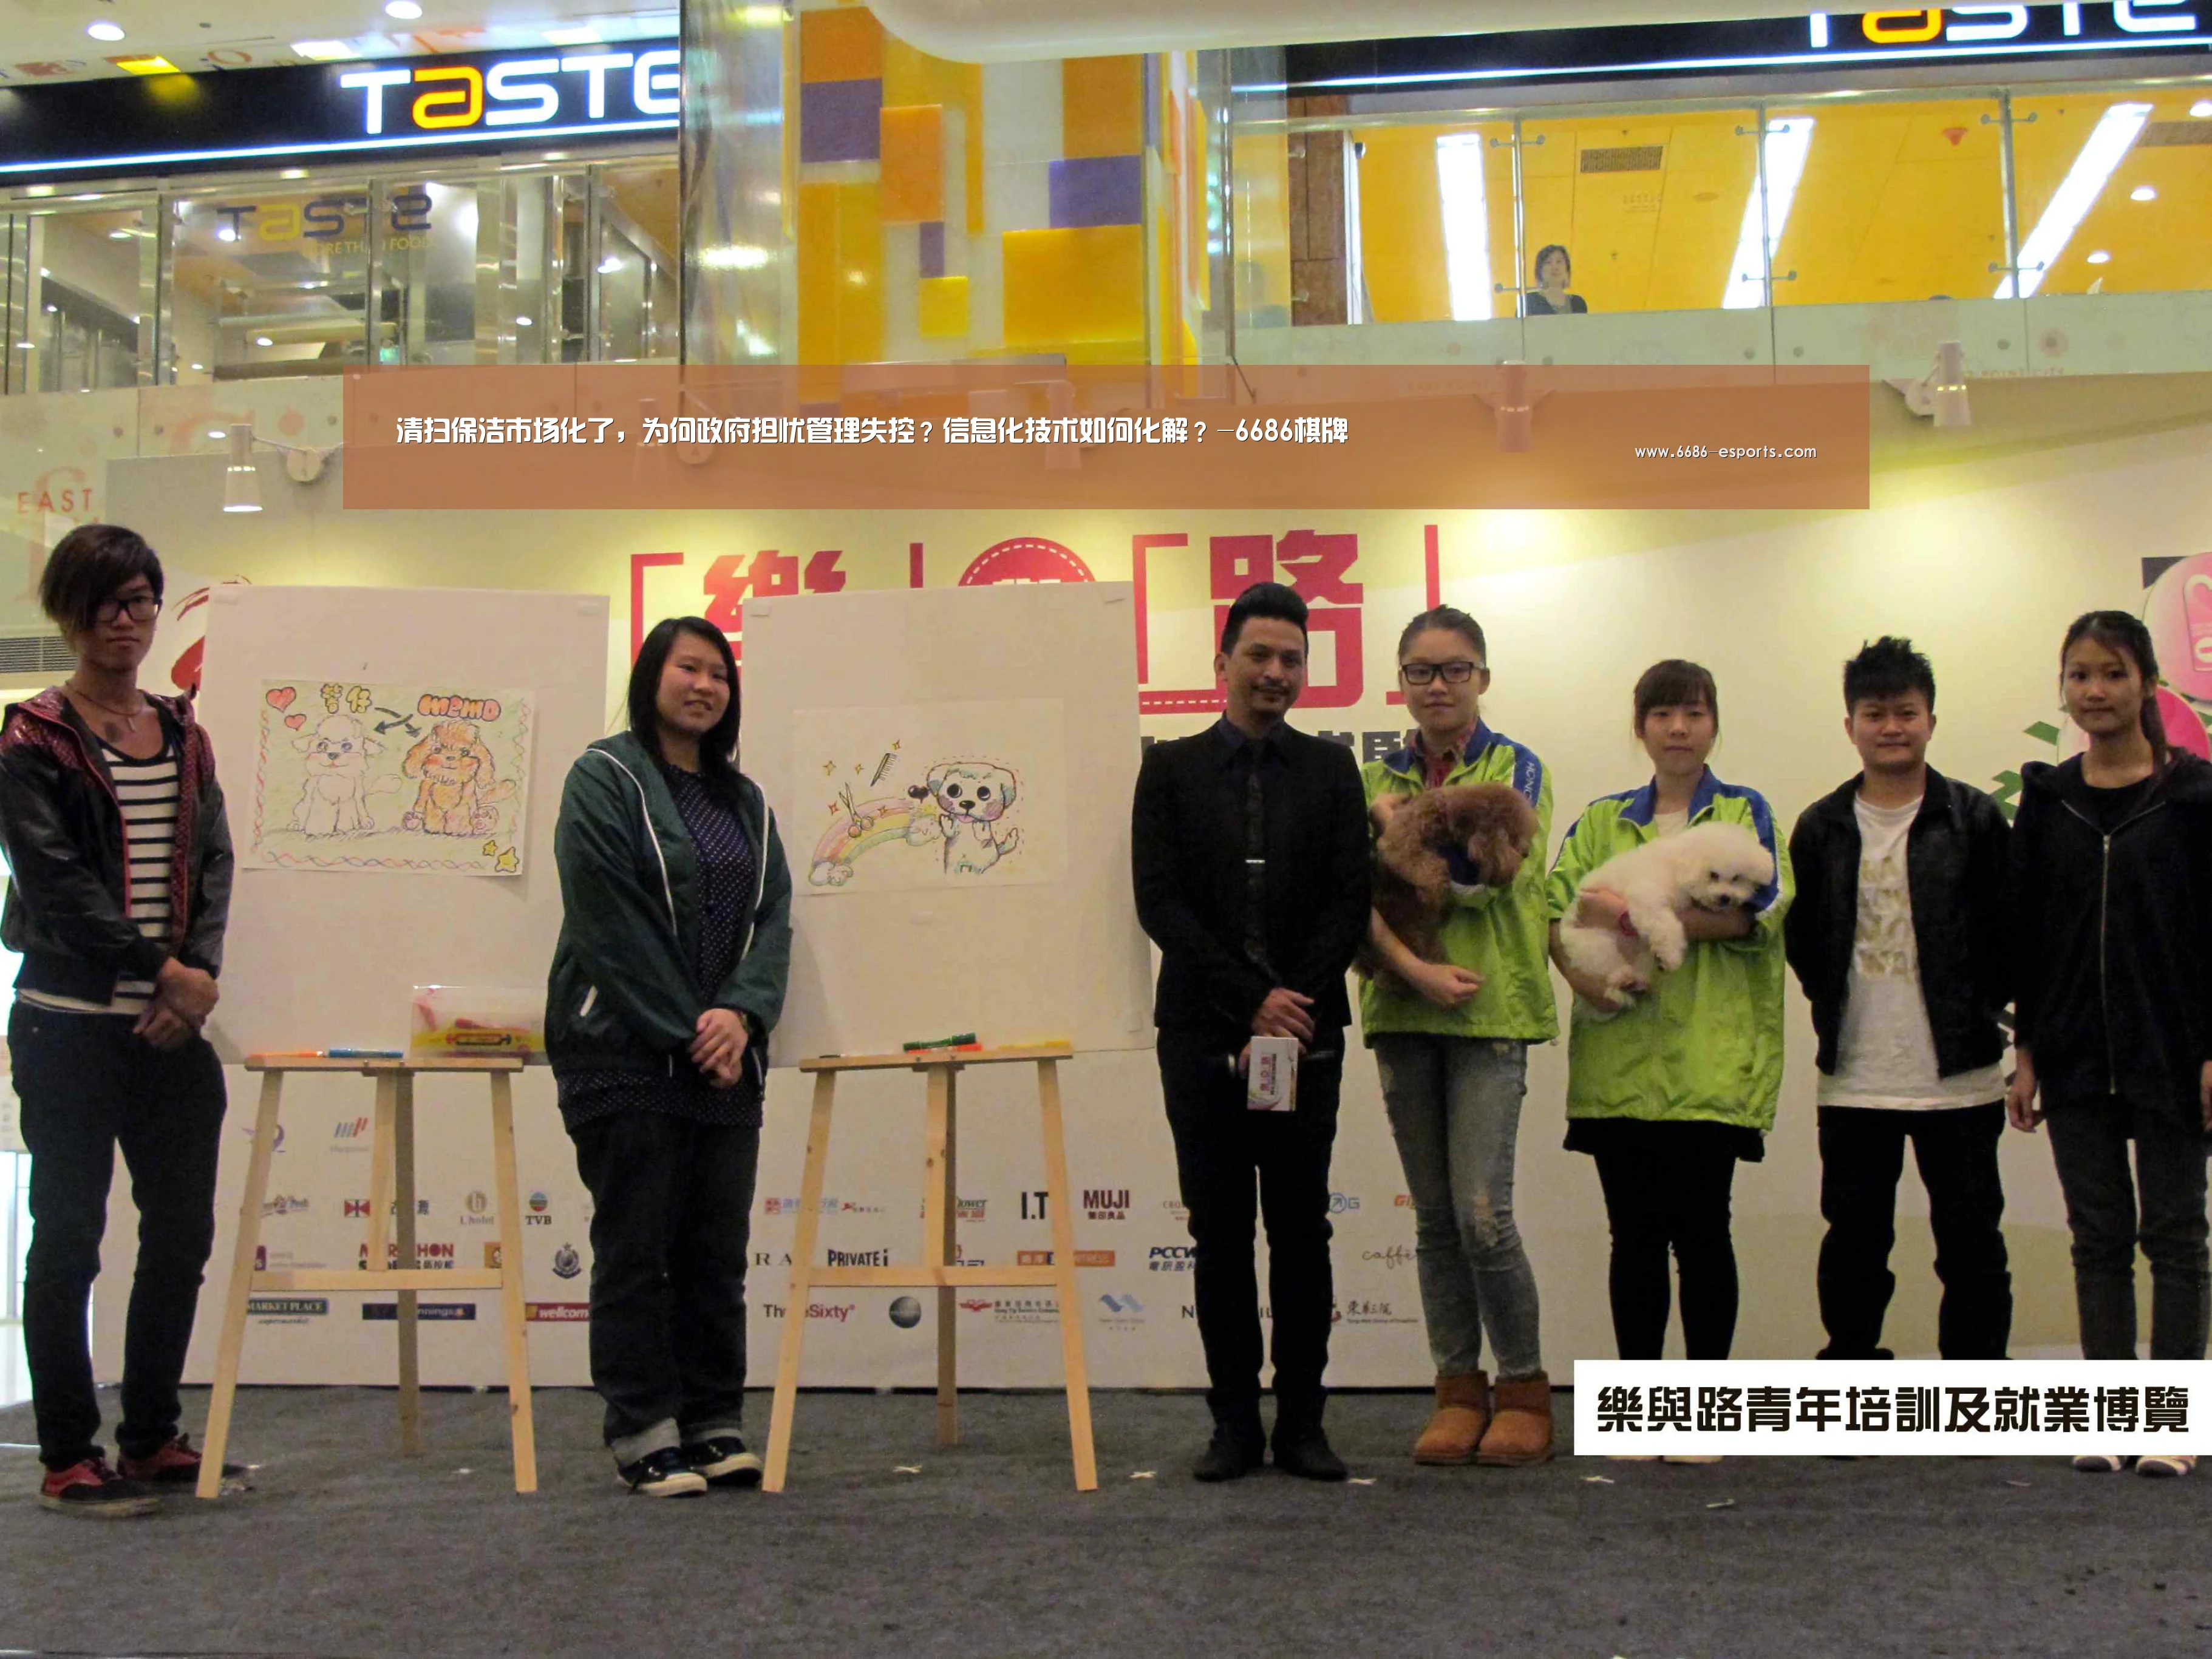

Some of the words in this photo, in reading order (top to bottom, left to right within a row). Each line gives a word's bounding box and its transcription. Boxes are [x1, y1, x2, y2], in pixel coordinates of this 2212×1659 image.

[17, 488, 93, 515] EAST
[1083, 1190, 1129, 1209] MUJI
[526, 1215, 552, 1225] TVB
[828, 1249, 879, 1267] PRIVATE
[539, 1307, 590, 1318] wellcom
